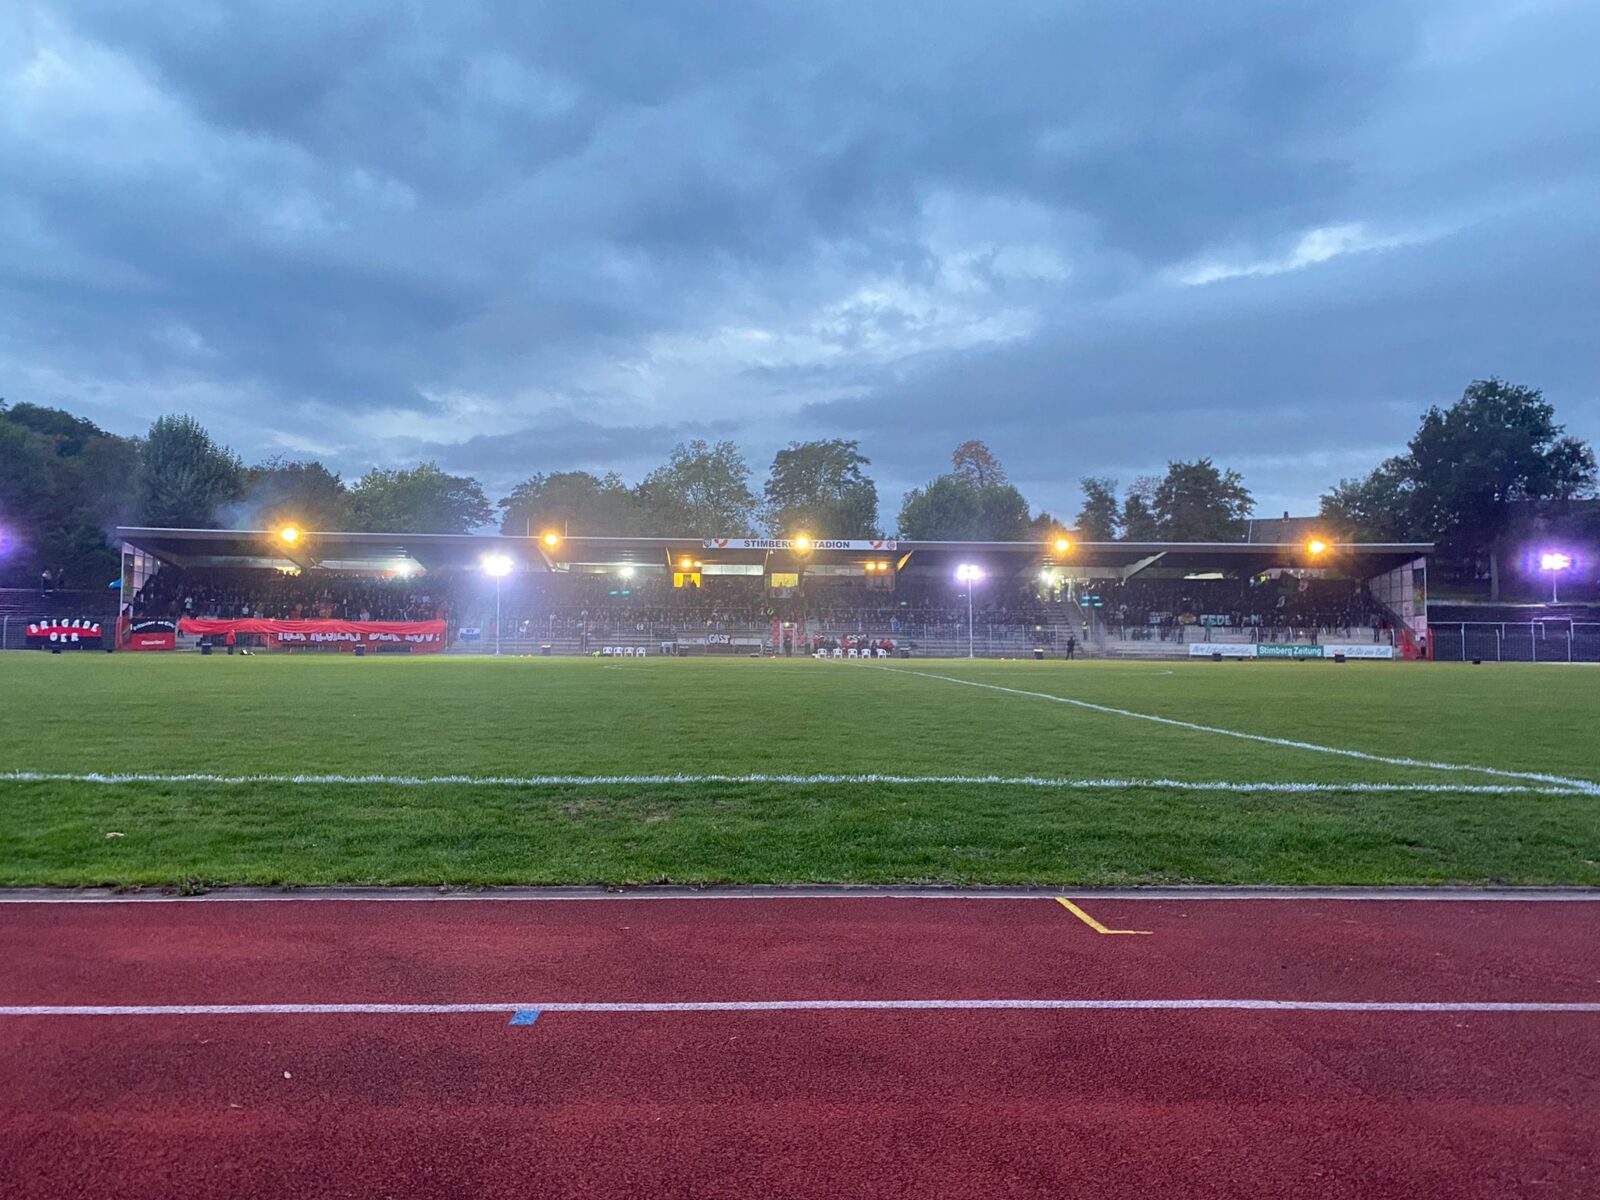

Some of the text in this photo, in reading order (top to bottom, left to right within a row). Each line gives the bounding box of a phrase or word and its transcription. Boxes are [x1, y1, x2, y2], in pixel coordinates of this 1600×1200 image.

[30, 618, 100, 633] BRIGADE
[49, 632, 79, 643] OER
[1259, 645, 1293, 656] Stimberg
[1293, 645, 1322, 656] Zeitung
